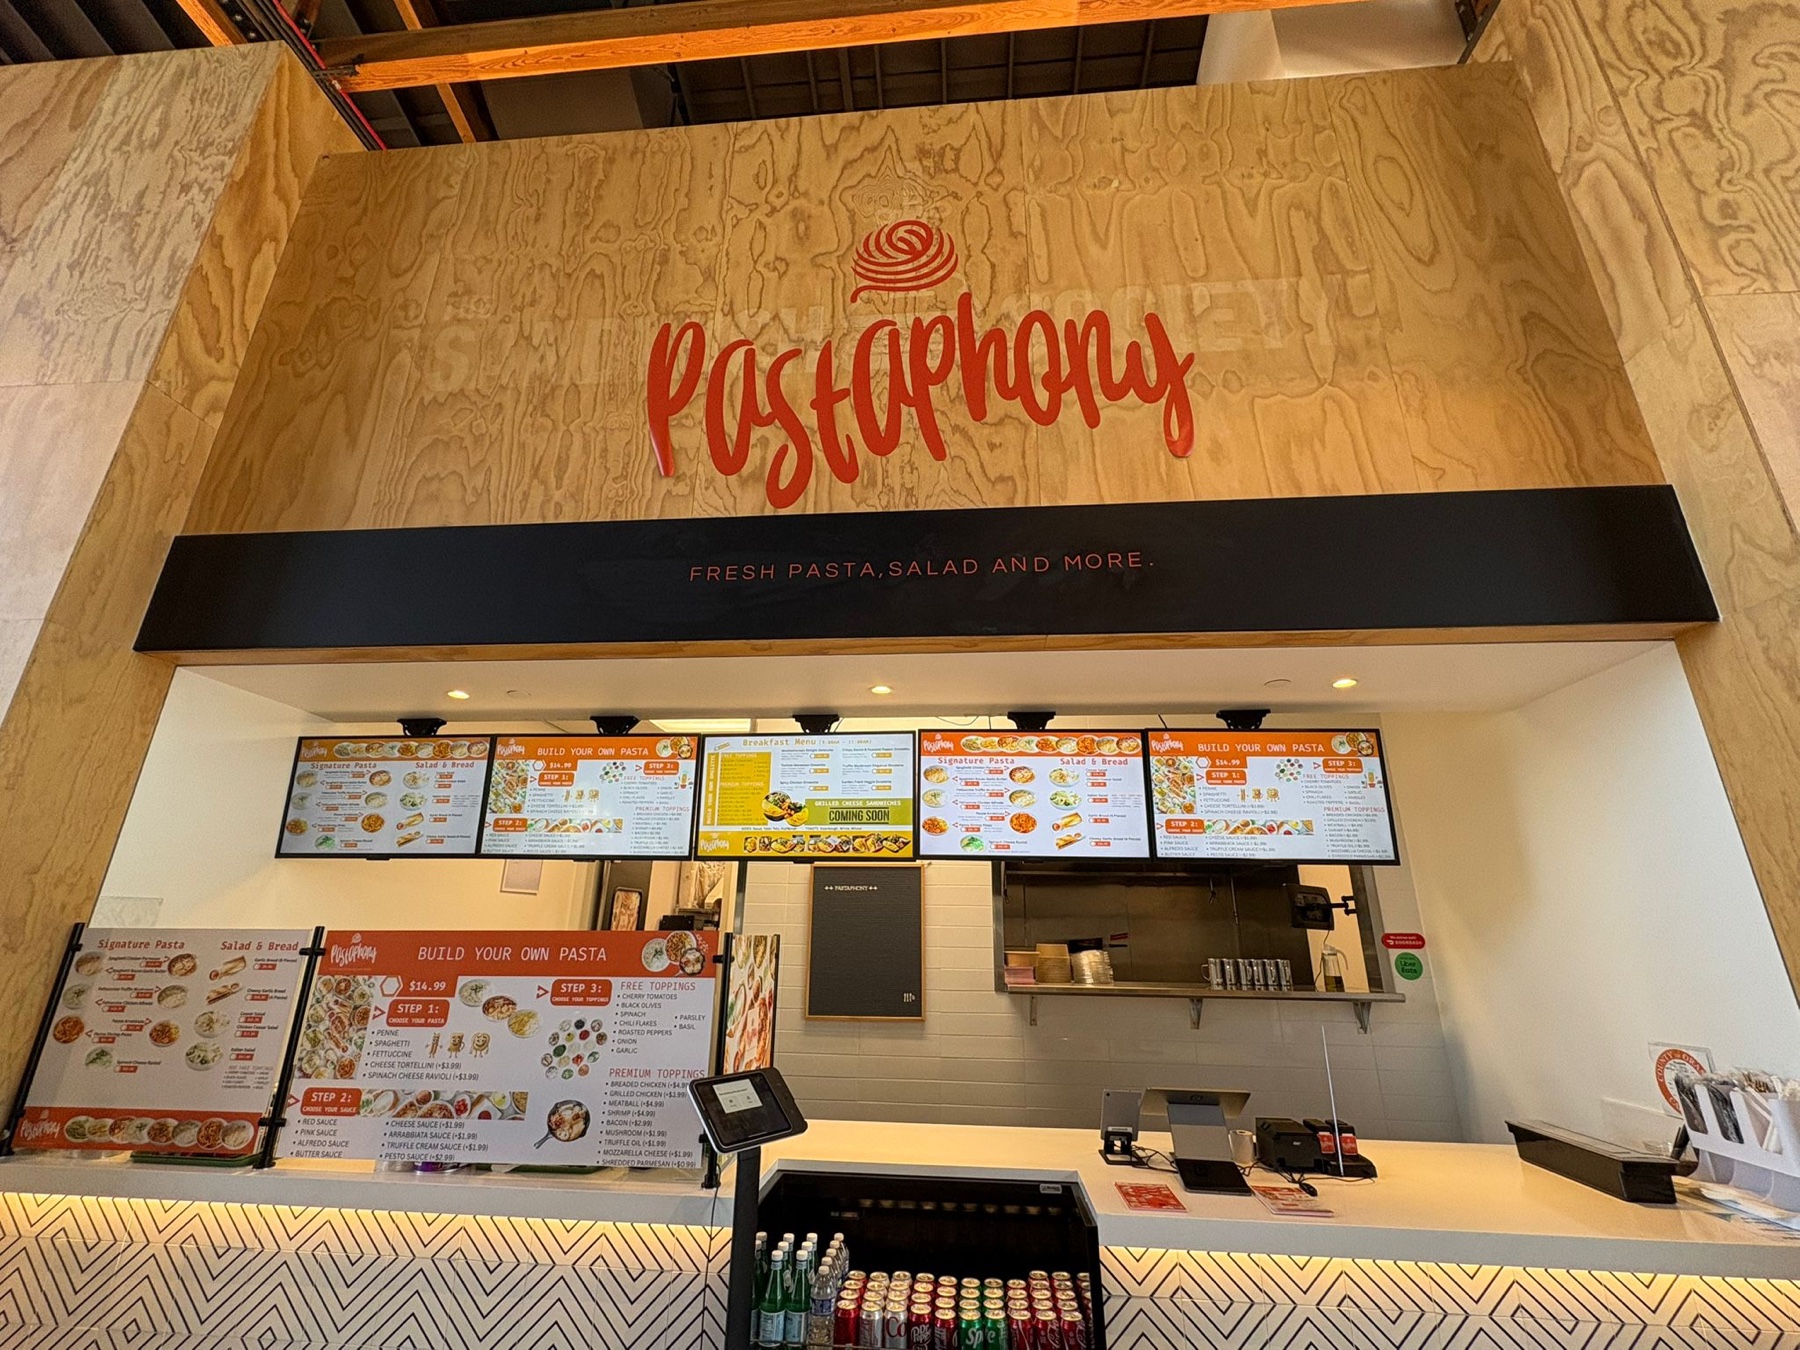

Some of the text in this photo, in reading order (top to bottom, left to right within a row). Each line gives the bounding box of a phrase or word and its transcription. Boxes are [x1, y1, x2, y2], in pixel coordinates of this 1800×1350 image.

[647, 292, 1195, 509] Pastaphony
[689, 563, 776, 583] FRESH
[992, 555, 1050, 574] AND
[1064, 551, 1155, 571] MORE.
[743, 737, 816, 747] Breakfast Menu
[1198, 744, 1325, 752] BUILD YOUR OWN PASTA
[938, 757, 984, 765] Signature
[829, 809, 890, 822] COMING SOON
[97, 939, 185, 950] Signature Pasta
[221, 941, 299, 951] Salad & Bread
[418, 947, 606, 961] BUILD YOUR OWN PASTA
[410, 981, 446, 991] $14.99
[561, 983, 602, 993] STEP 3:
[621, 981, 696, 991] FREE TOPPINGS
[397, 1004, 439, 1013] STEP 1:
[397, 1061, 434, 1069] TORTELLINI
[609, 1068, 704, 1079] PREMIUM TOPPINGS
[311, 1093, 351, 1102] STEP 2:
